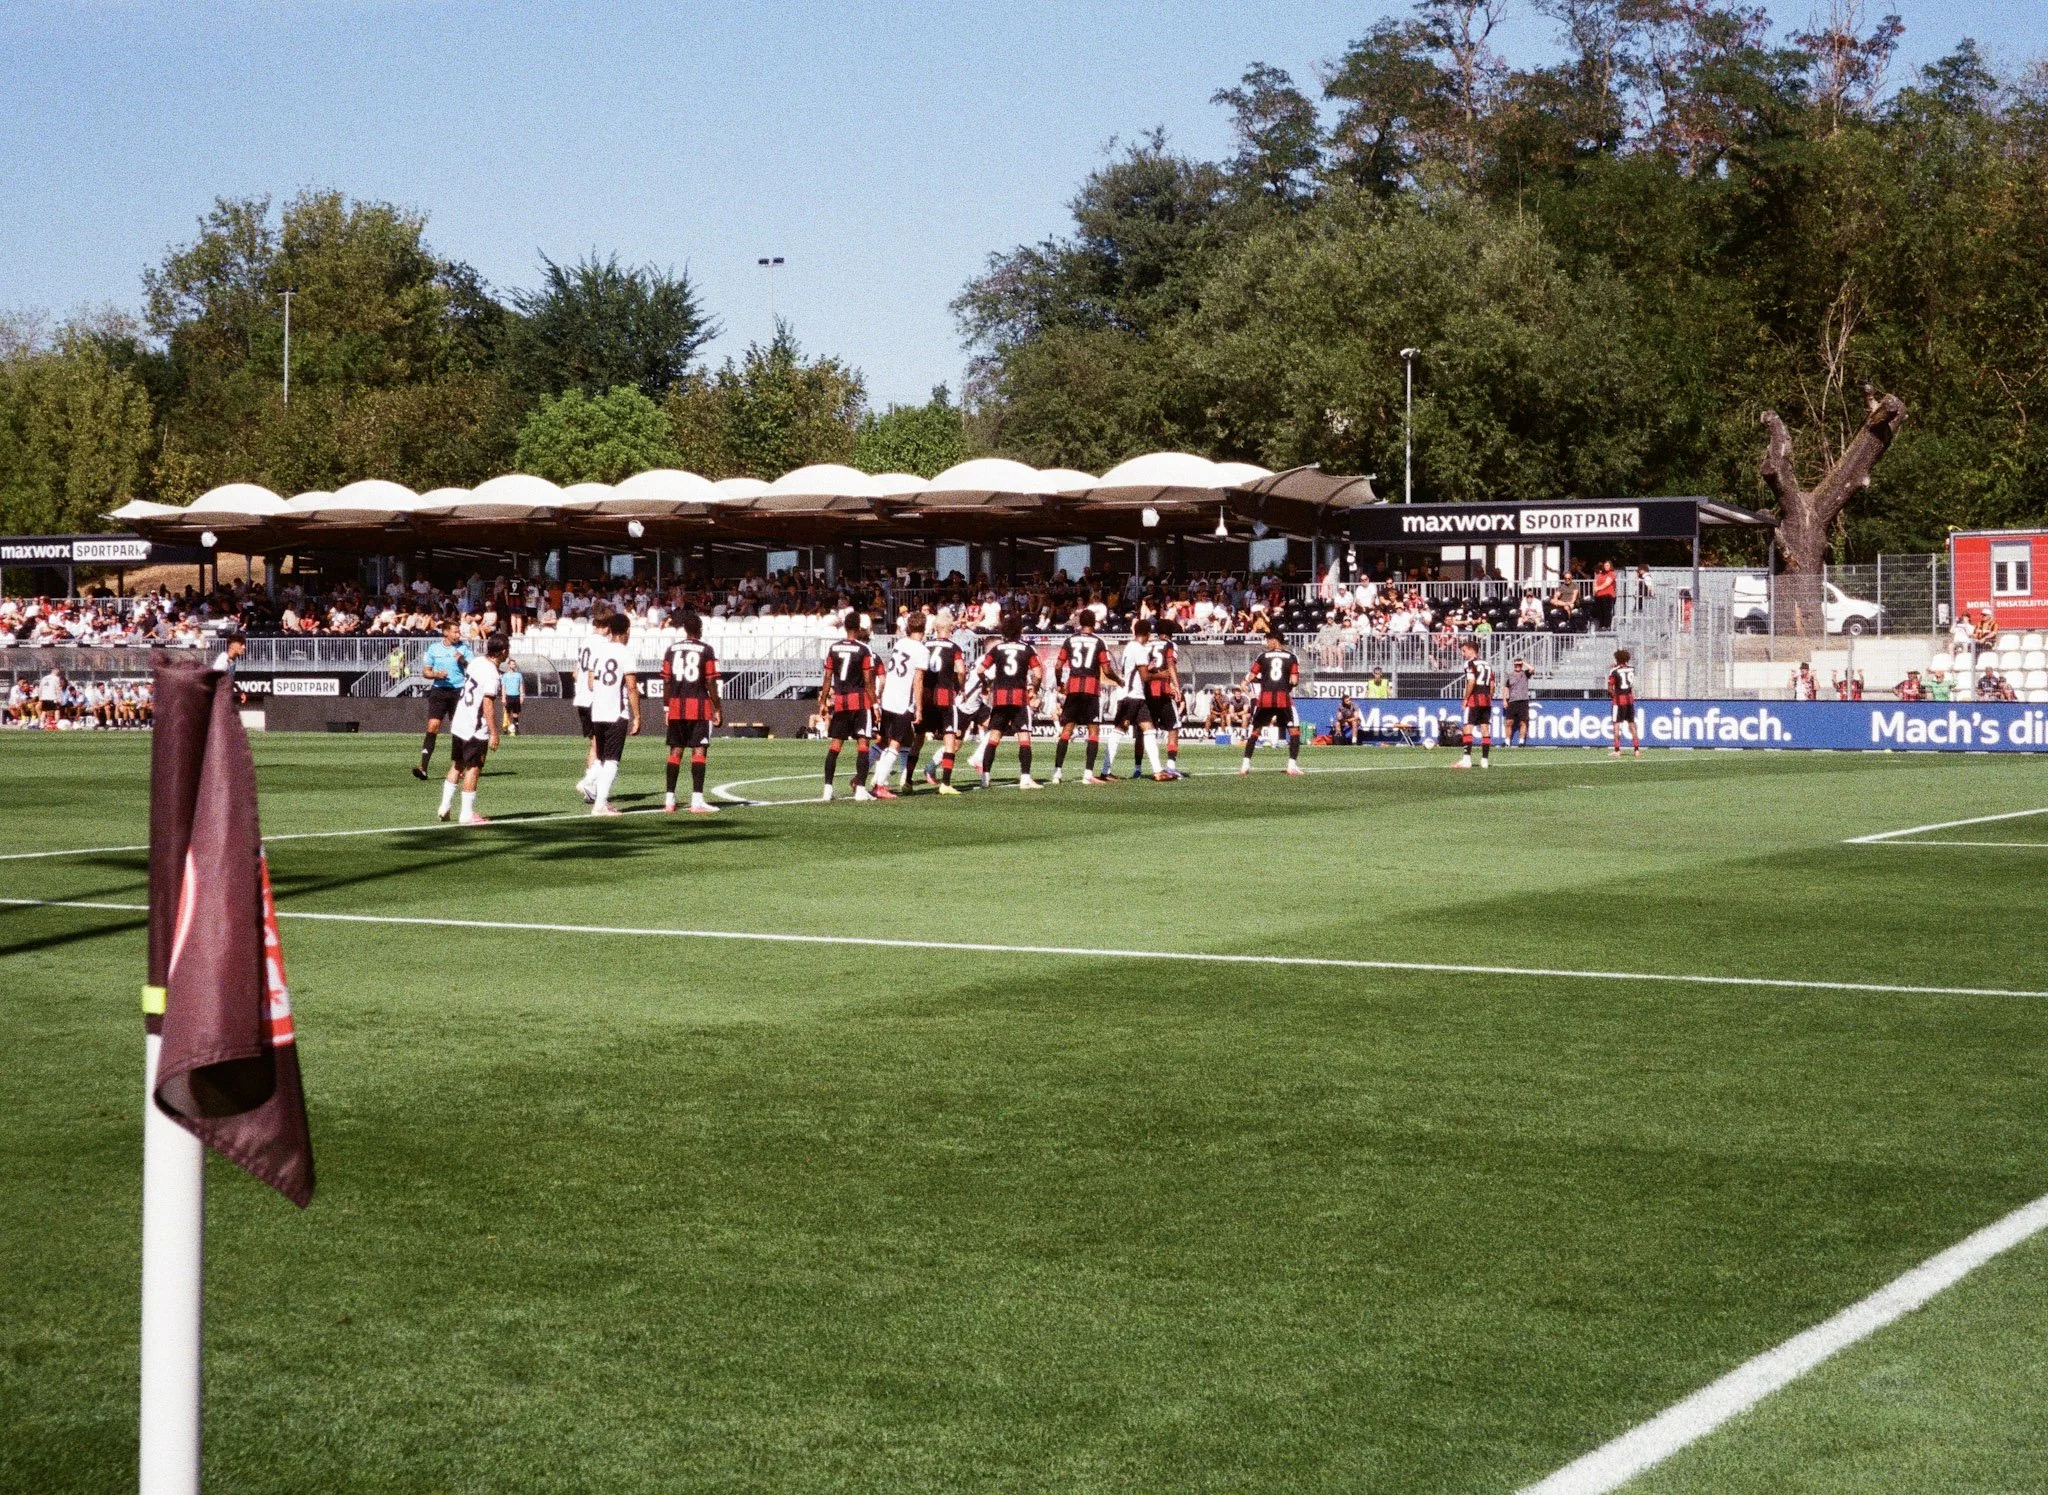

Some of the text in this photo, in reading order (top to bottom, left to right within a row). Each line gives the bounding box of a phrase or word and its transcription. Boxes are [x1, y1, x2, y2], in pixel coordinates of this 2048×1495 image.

[1402, 513, 1634, 532] maxworx SPORTPARK
[1, 544, 71, 559] maxworx
[511, 582, 518, 593] 9
[579, 647, 591, 672] 0
[672, 651, 700, 682] 48
[838, 652, 851, 681] 7
[1003, 649, 1018, 676] 3
[1071, 642, 1097, 668] 37
[1270, 657, 1283, 681] 8
[1475, 664, 1492, 686] 27
[276, 681, 336, 693] SPORTPARK
[1313, 685, 1365, 697] SPORTP
[1651, 707, 1792, 741] einfach.
[1871, 710, 2048, 744] Mach's di
